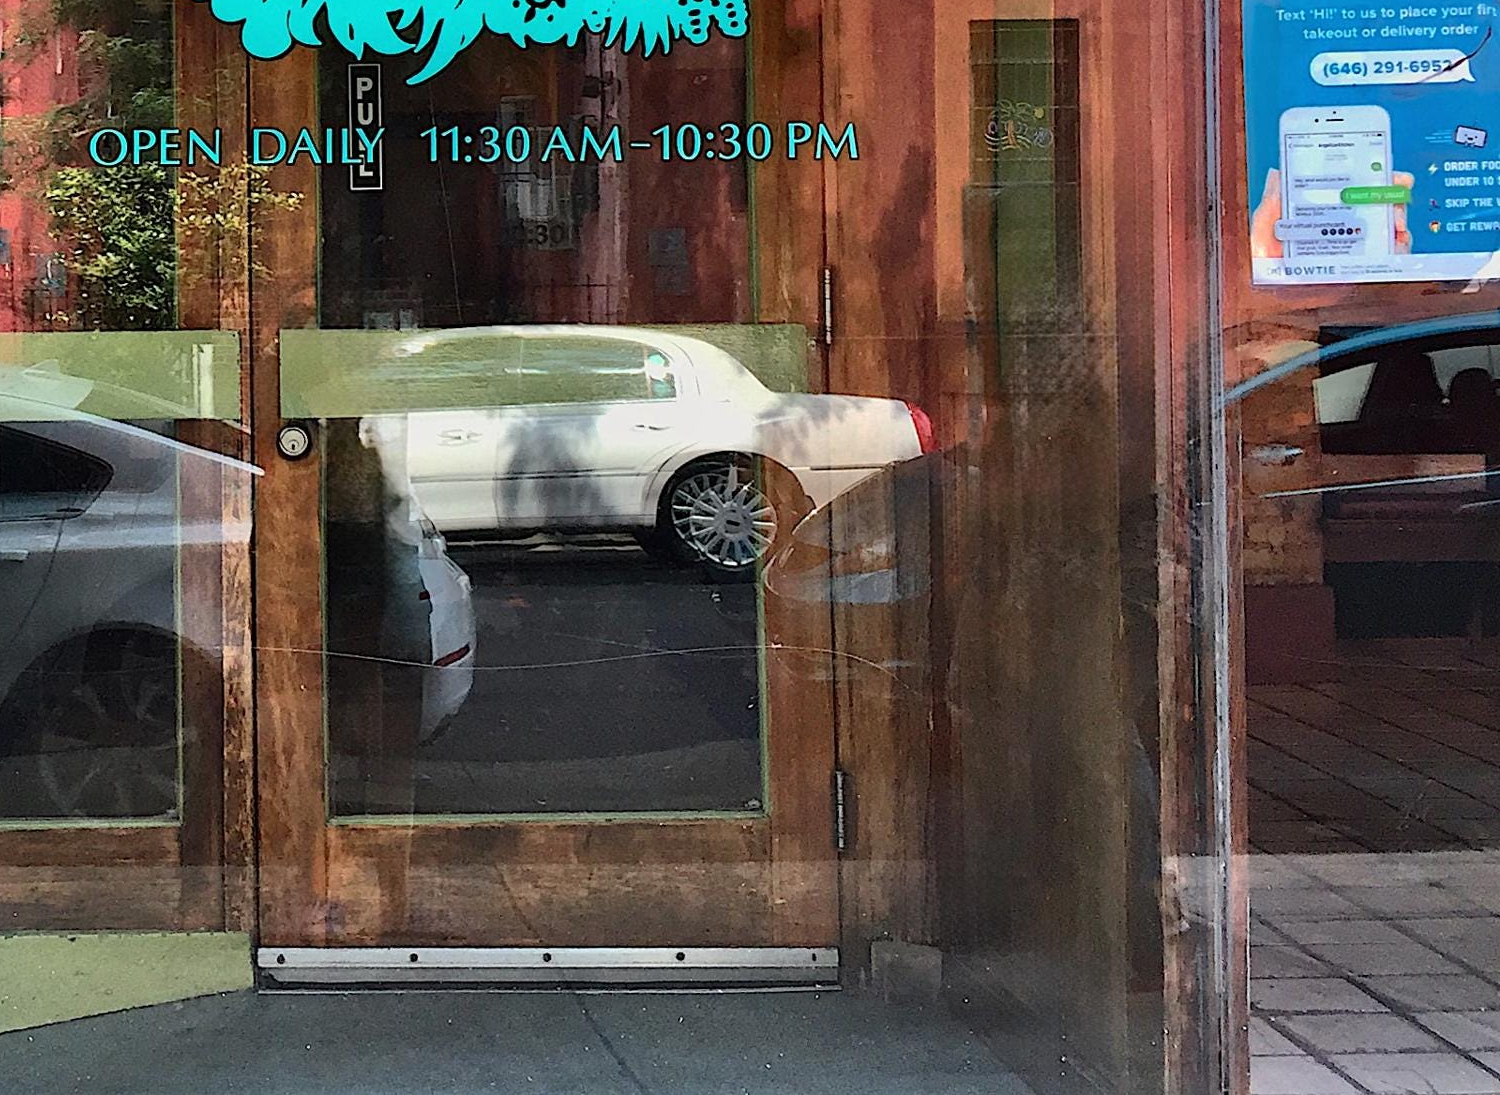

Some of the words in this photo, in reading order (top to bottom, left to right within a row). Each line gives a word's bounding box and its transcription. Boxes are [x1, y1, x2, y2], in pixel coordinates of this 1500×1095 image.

[1275, 9, 1306, 21] Text
[1342, 9, 1356, 19] to
[1360, 9, 1377, 19] us
[1381, 7, 1395, 18] to
[1400, 5, 1438, 20] place
[1441, 6, 1473, 19] your
[1303, 27, 1358, 39] takeout
[1361, 28, 1376, 37] or
[1380, 25, 1437, 39] delivery
[1441, 24, 1479, 36] order
[1323, 62, 1368, 78] (646)
[87, 126, 222, 167] OPEN
[251, 125, 386, 165] DAILY
[419, 123, 531, 163] 11:30
[786, 121, 859, 161] PM
[1444, 161, 1478, 172] ORDER
[1444, 176, 1480, 187] UNDER
[1482, 176, 1495, 186] 10
[1444, 198, 1470, 208] SKIP
[1472, 197, 1494, 207] THE
[1445, 222, 1467, 232] GET
[1284, 265, 1336, 276] BOWTIE
